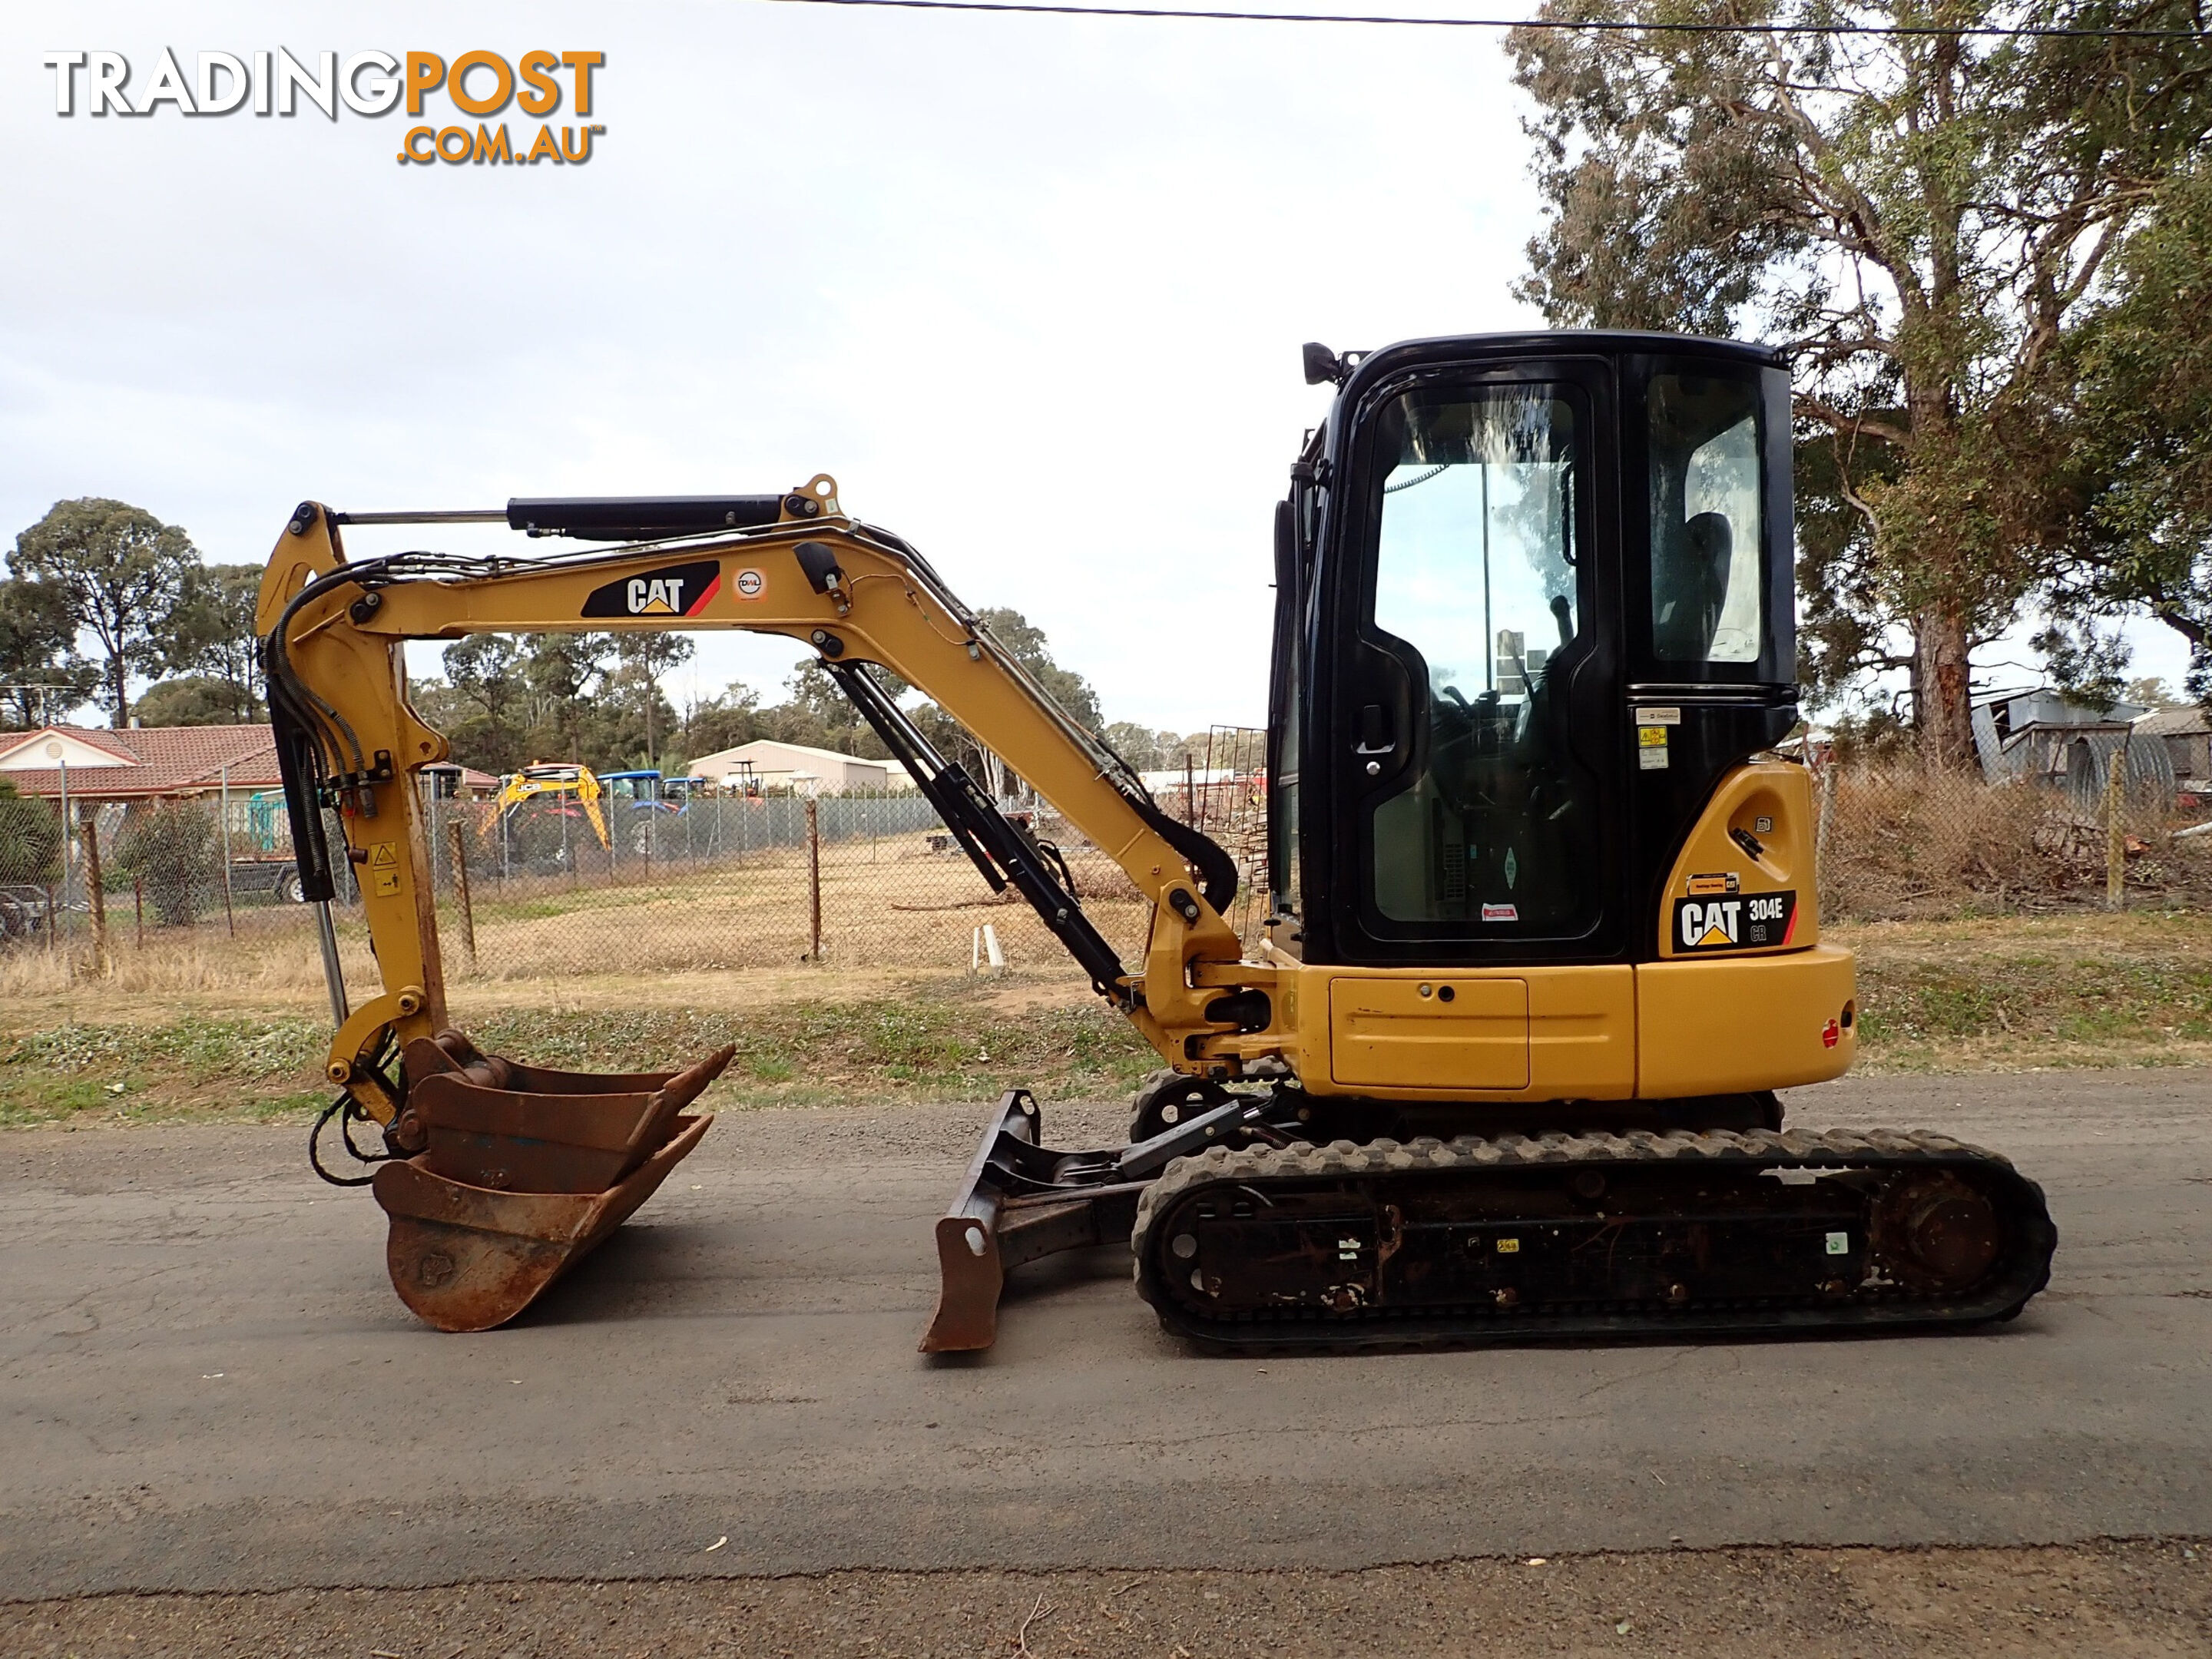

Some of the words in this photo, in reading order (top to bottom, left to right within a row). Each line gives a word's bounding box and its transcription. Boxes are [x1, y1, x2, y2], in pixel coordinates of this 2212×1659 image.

[628, 578, 684, 614] CAT
[517, 783, 541, 792] JCB
[1749, 897, 1783, 921] 304E
[1682, 901, 1741, 946] CAT
[1750, 925, 1767, 942] CR
